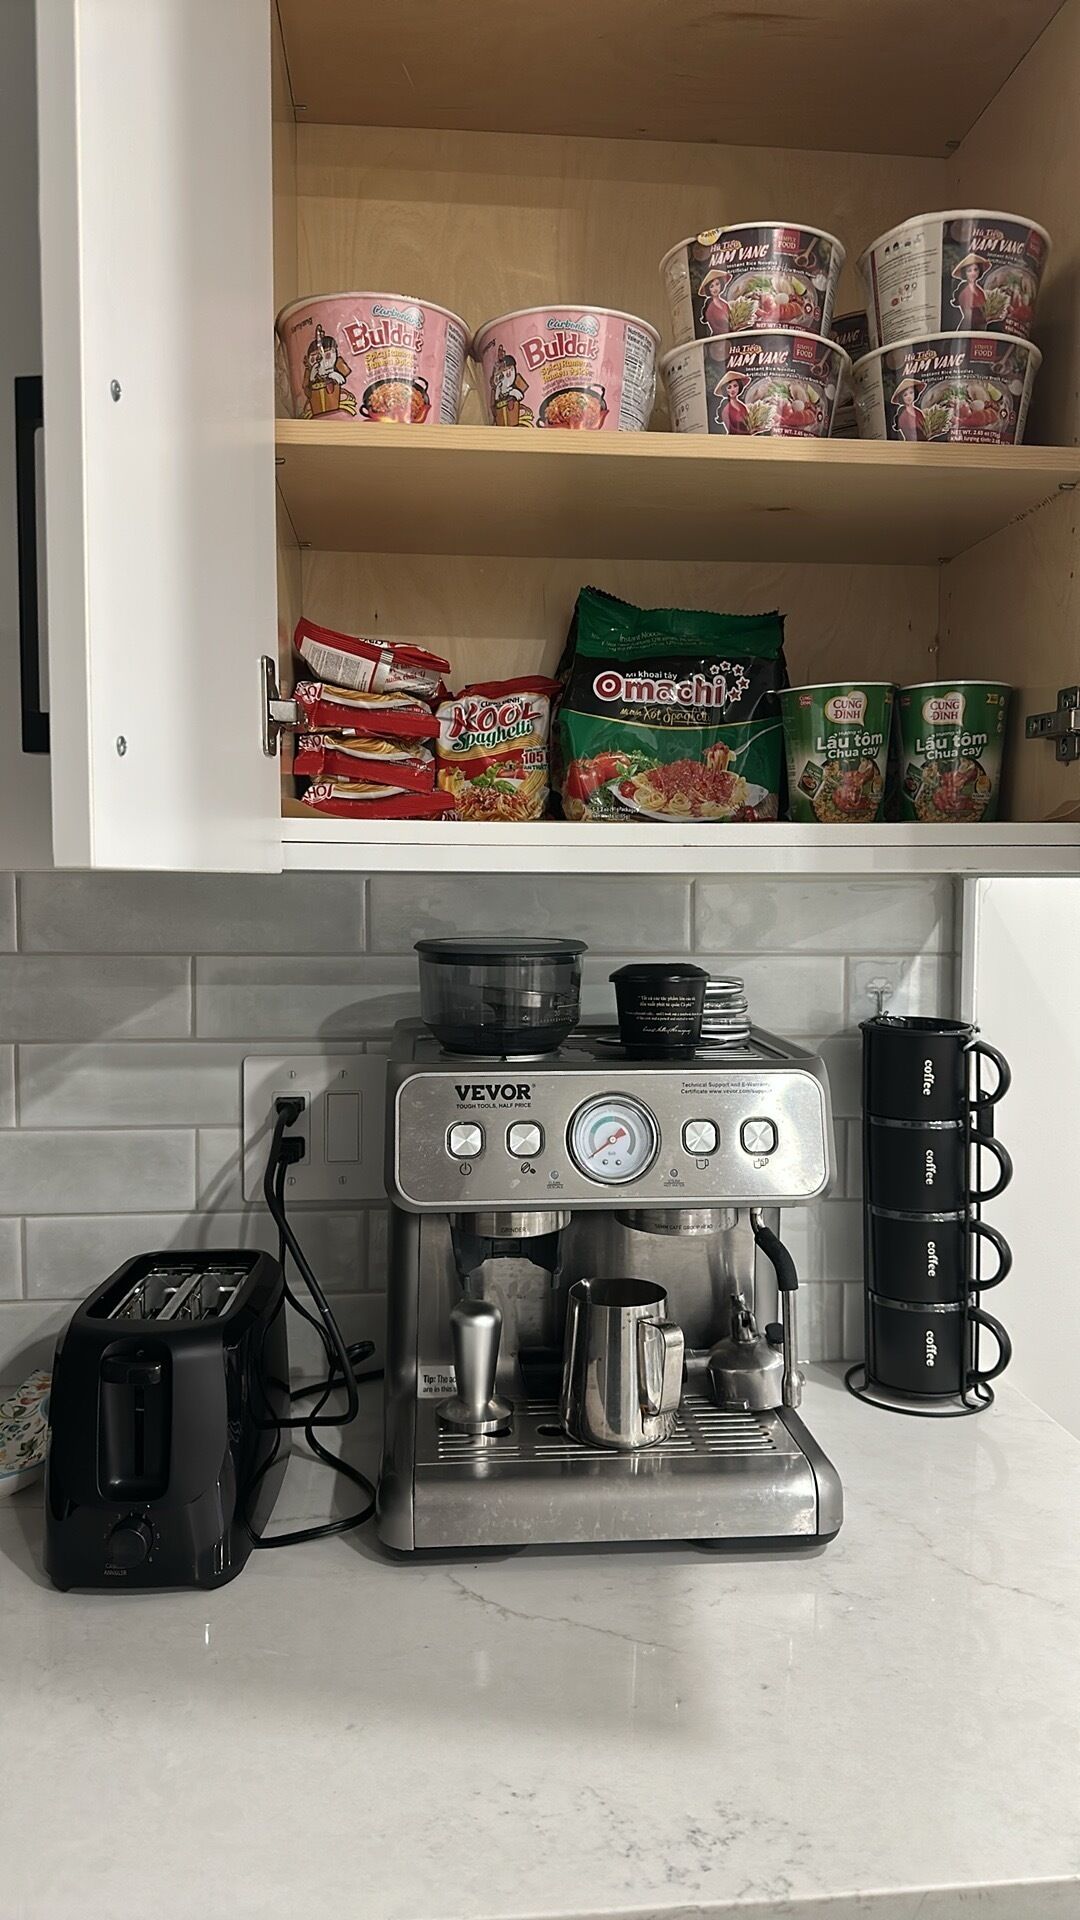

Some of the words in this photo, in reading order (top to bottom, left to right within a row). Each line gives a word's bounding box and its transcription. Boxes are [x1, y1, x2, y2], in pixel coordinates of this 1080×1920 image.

[777, 241, 796, 250] FOOD
[968, 239, 998, 252] NAM
[999, 241, 1025, 254] VANG
[709, 251, 736, 267] NAM
[738, 244, 769, 261] VANG
[343, 319, 423, 355] Buldak
[520, 332, 599, 371] Buldak
[727, 353, 757, 368] NAM
[758, 351, 788, 366] VANG
[796, 350, 813, 358] FOOD
[974, 349, 993, 357] FOOD
[902, 360, 931, 376] NAM
[934, 353, 965, 370] VANG
[638, 670, 662, 678] khoai
[664, 671, 678, 681] tây
[593, 670, 726, 707] Omachi
[833, 700, 862, 709] CUNG
[930, 700, 960, 710] CUNG
[449, 701, 543, 739] KOOL
[452, 719, 534, 752] Spaghetti
[816, 733, 849, 751] Lẩu
[854, 731, 883, 747] tôm
[916, 734, 948, 752] Lẩu
[952, 732, 987, 747] tôm
[523, 750, 545, 765] 105
[828, 749, 859, 759] Chua
[861, 746, 879, 757] cay
[926, 749, 958, 760] Chua
[962, 746, 982, 757] cay
[922, 1059, 935, 1096] coffee
[455, 1084, 531, 1100] VEVOR
[925, 1149, 936, 1185] coffee
[927, 1241, 939, 1277] coffee
[925, 1330, 937, 1367] coffee
[423, 1375, 436, 1384] Tip:
[437, 1375, 448, 1383] The
